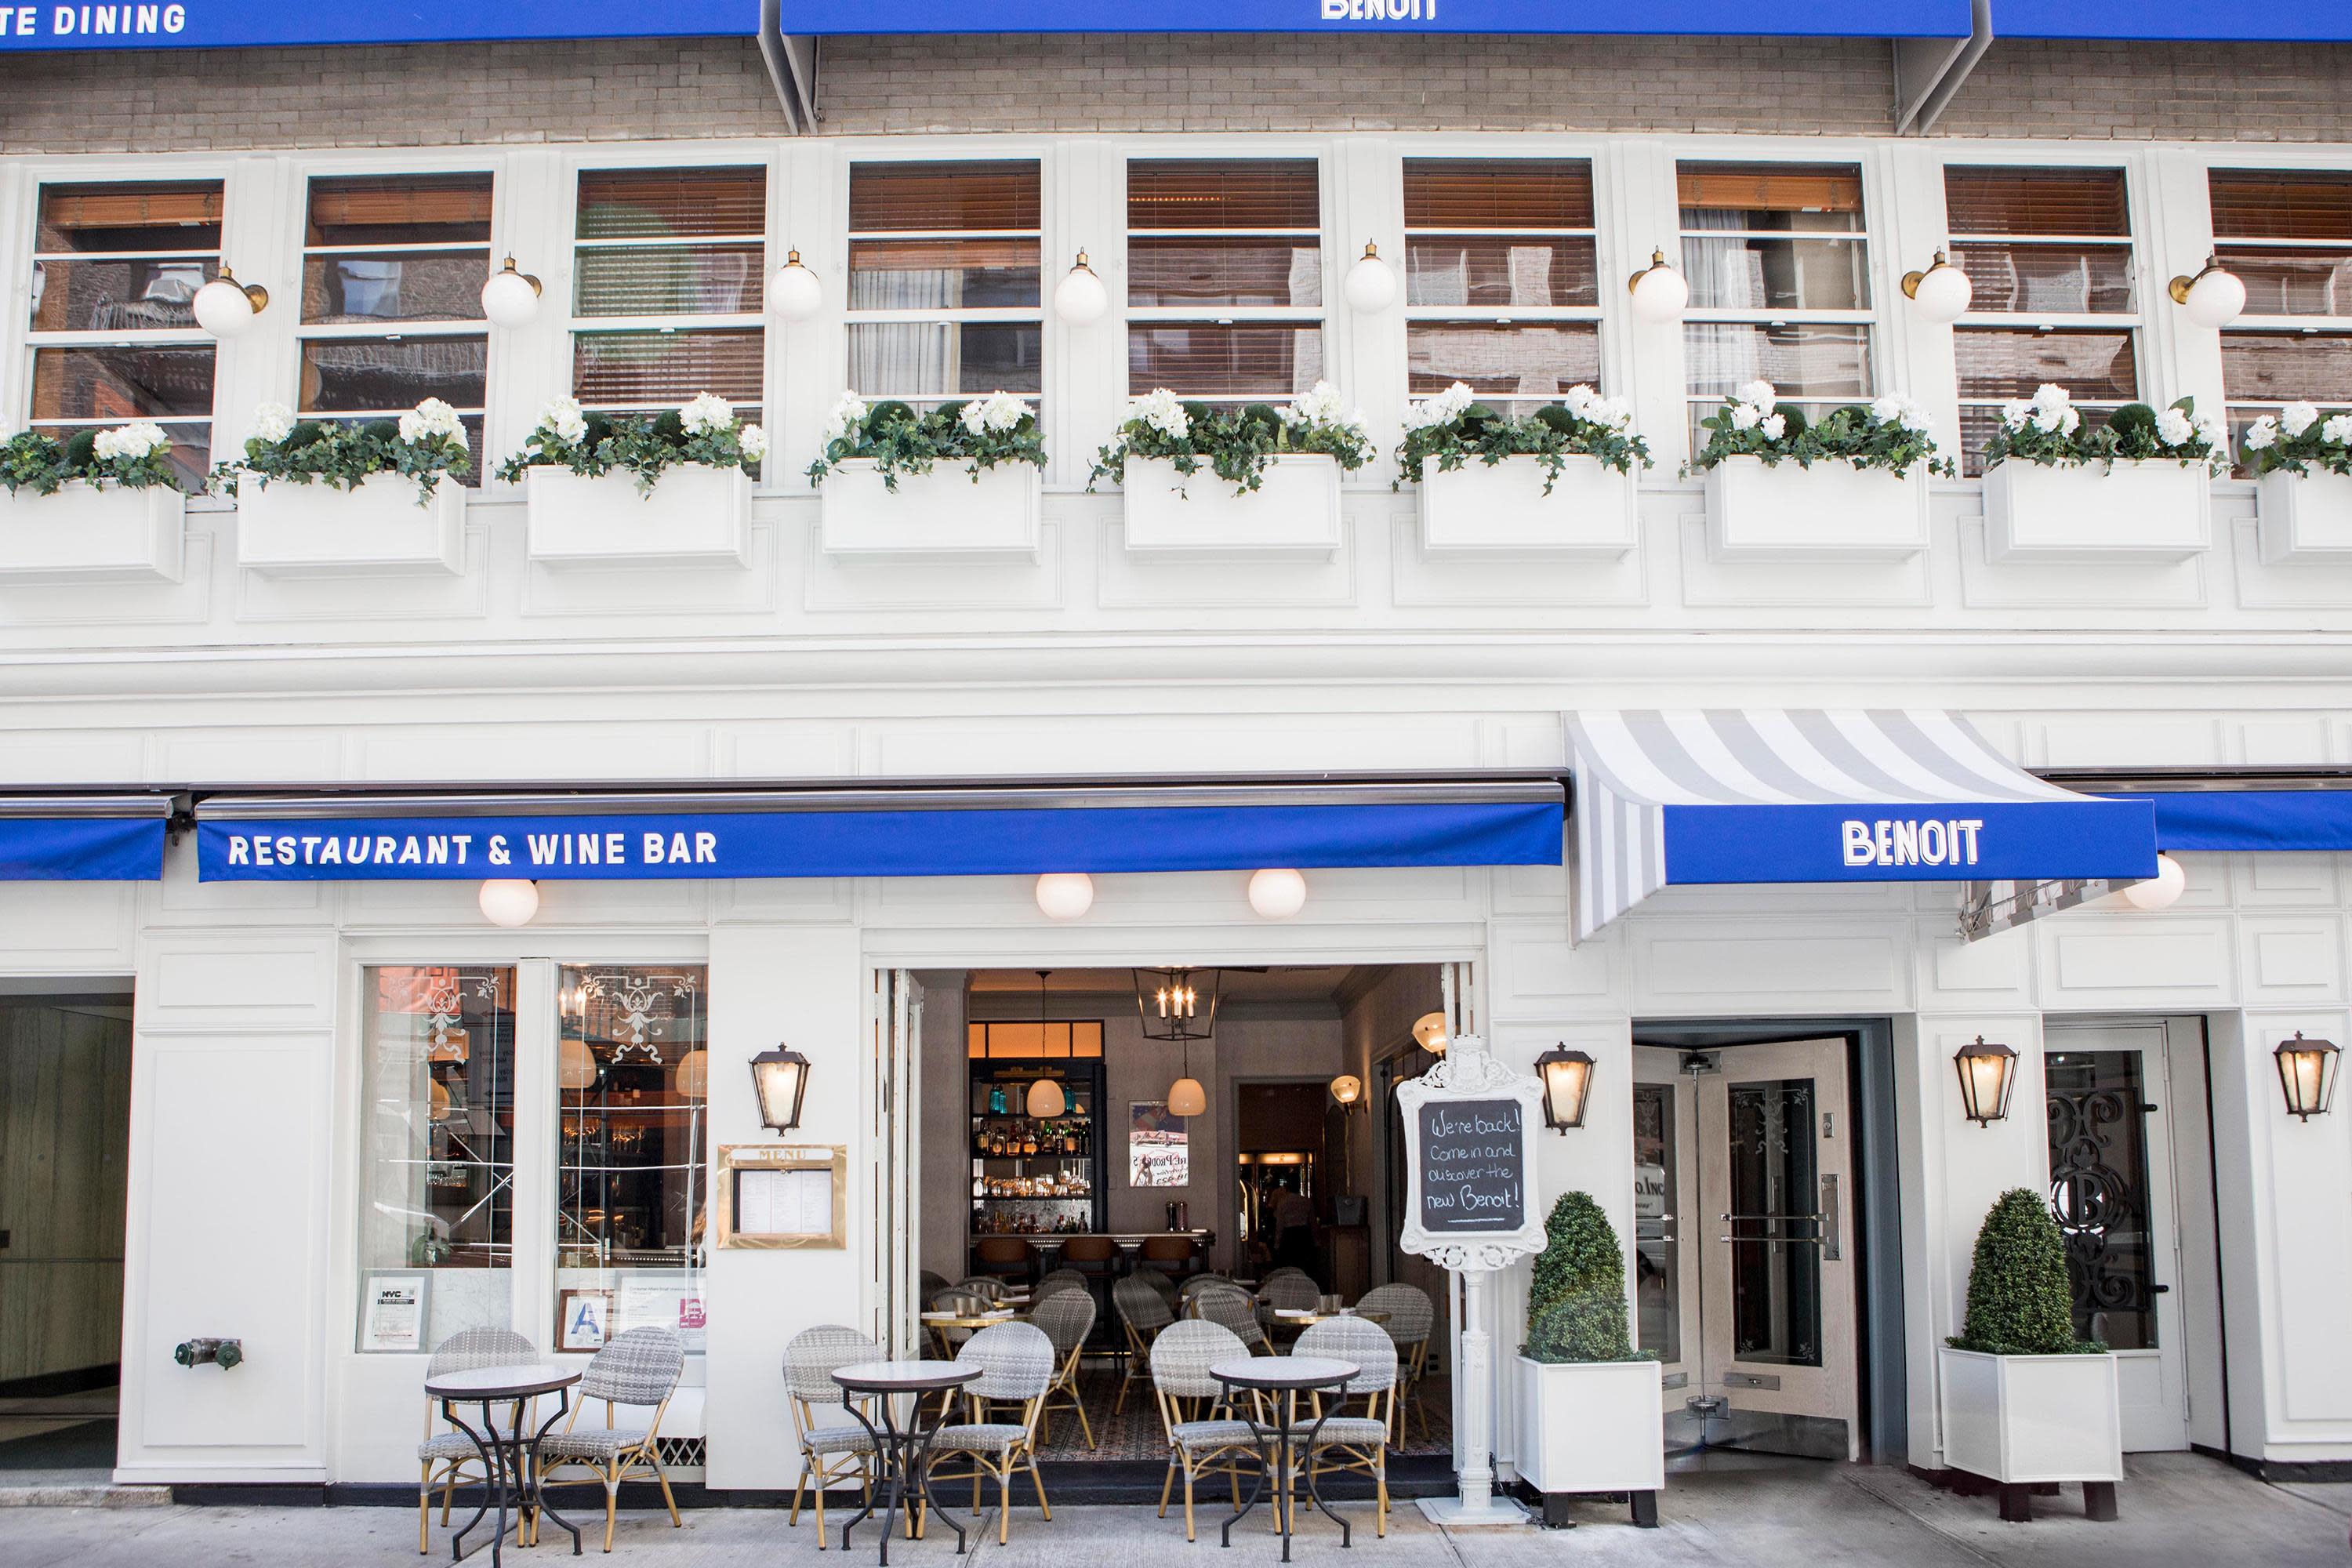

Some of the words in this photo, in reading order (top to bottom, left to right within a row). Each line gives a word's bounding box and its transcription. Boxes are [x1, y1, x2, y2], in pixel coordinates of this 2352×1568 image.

[54, 5, 185, 34] DINING
[228, 834, 471, 866] RESTAURANT
[488, 834, 511, 866] &
[528, 833, 626, 865] WINE
[643, 832, 717, 864] BAR
[1842, 819, 1983, 866] BENOIT
[1432, 1109, 1473, 1138] We're
[1475, 1108, 1521, 1134] back!
[759, 1150, 807, 1160] MENU
[1430, 1145, 1468, 1161] Come
[1470, 1146, 1482, 1158] in
[1485, 1142, 1516, 1158] and
[1428, 1167, 1485, 1182] discover
[1486, 1163, 1513, 1179] the
[1426, 1192, 1456, 1210] new
[1459, 1181, 1519, 1210] Benoit!
[570, 1303, 600, 1334] A
